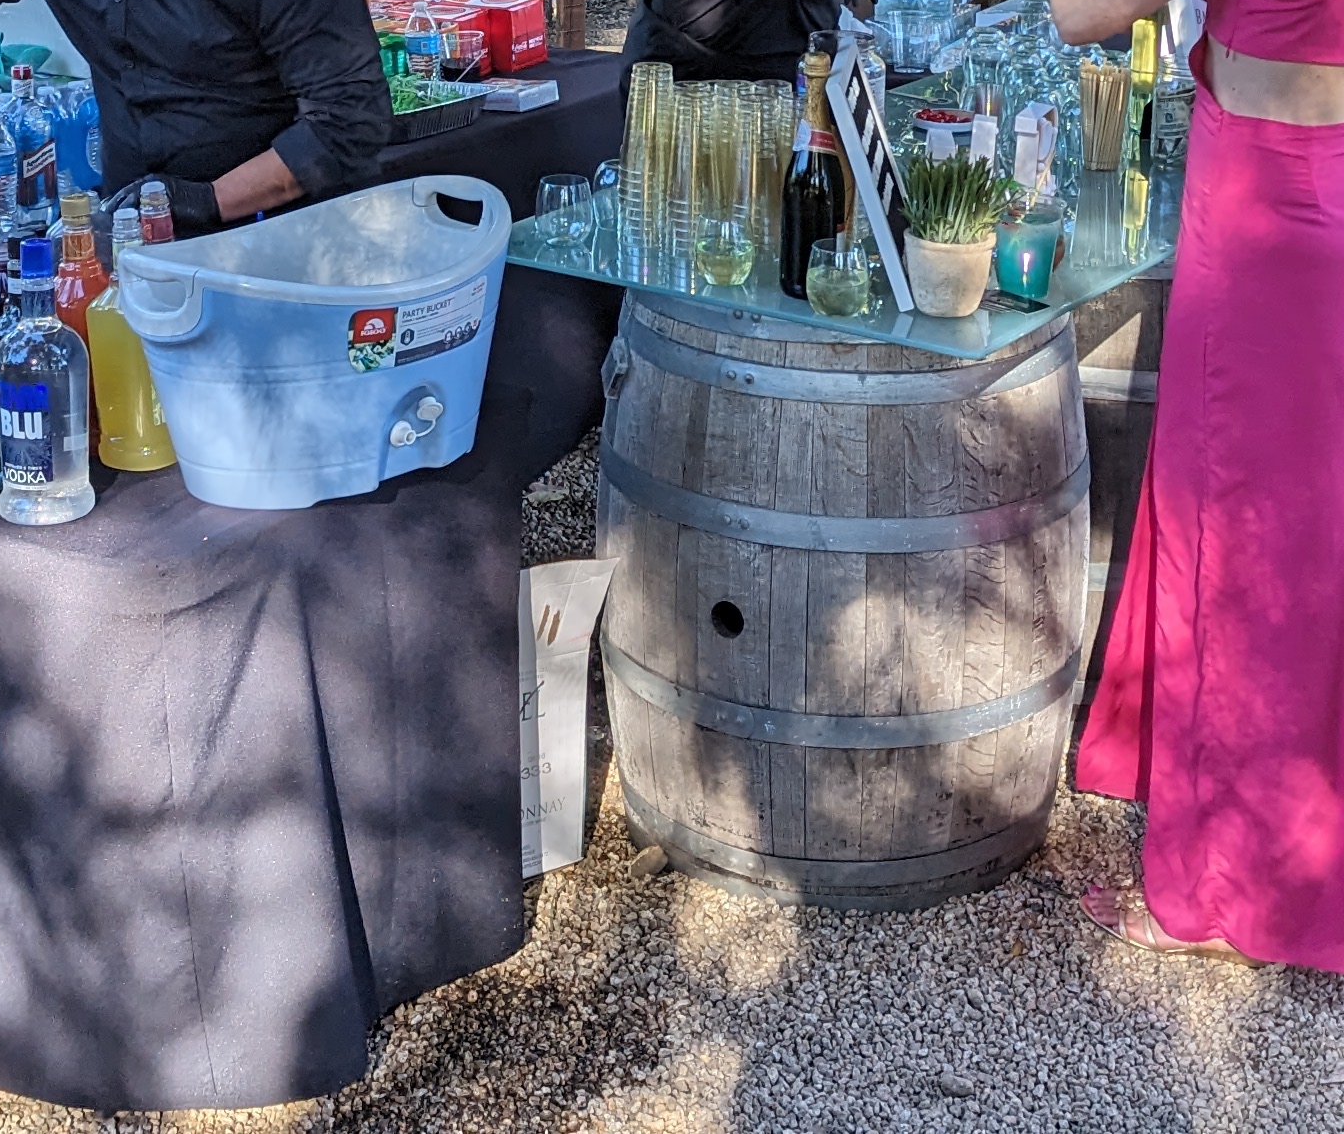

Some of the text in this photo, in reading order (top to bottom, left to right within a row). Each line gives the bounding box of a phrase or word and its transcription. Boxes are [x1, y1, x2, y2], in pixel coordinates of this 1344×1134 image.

[402, 305, 425, 319] PARTY
[426, 298, 452, 314] BUCKET
[0, 407, 43, 440] BLU
[4, 466, 47, 484] VODKA
